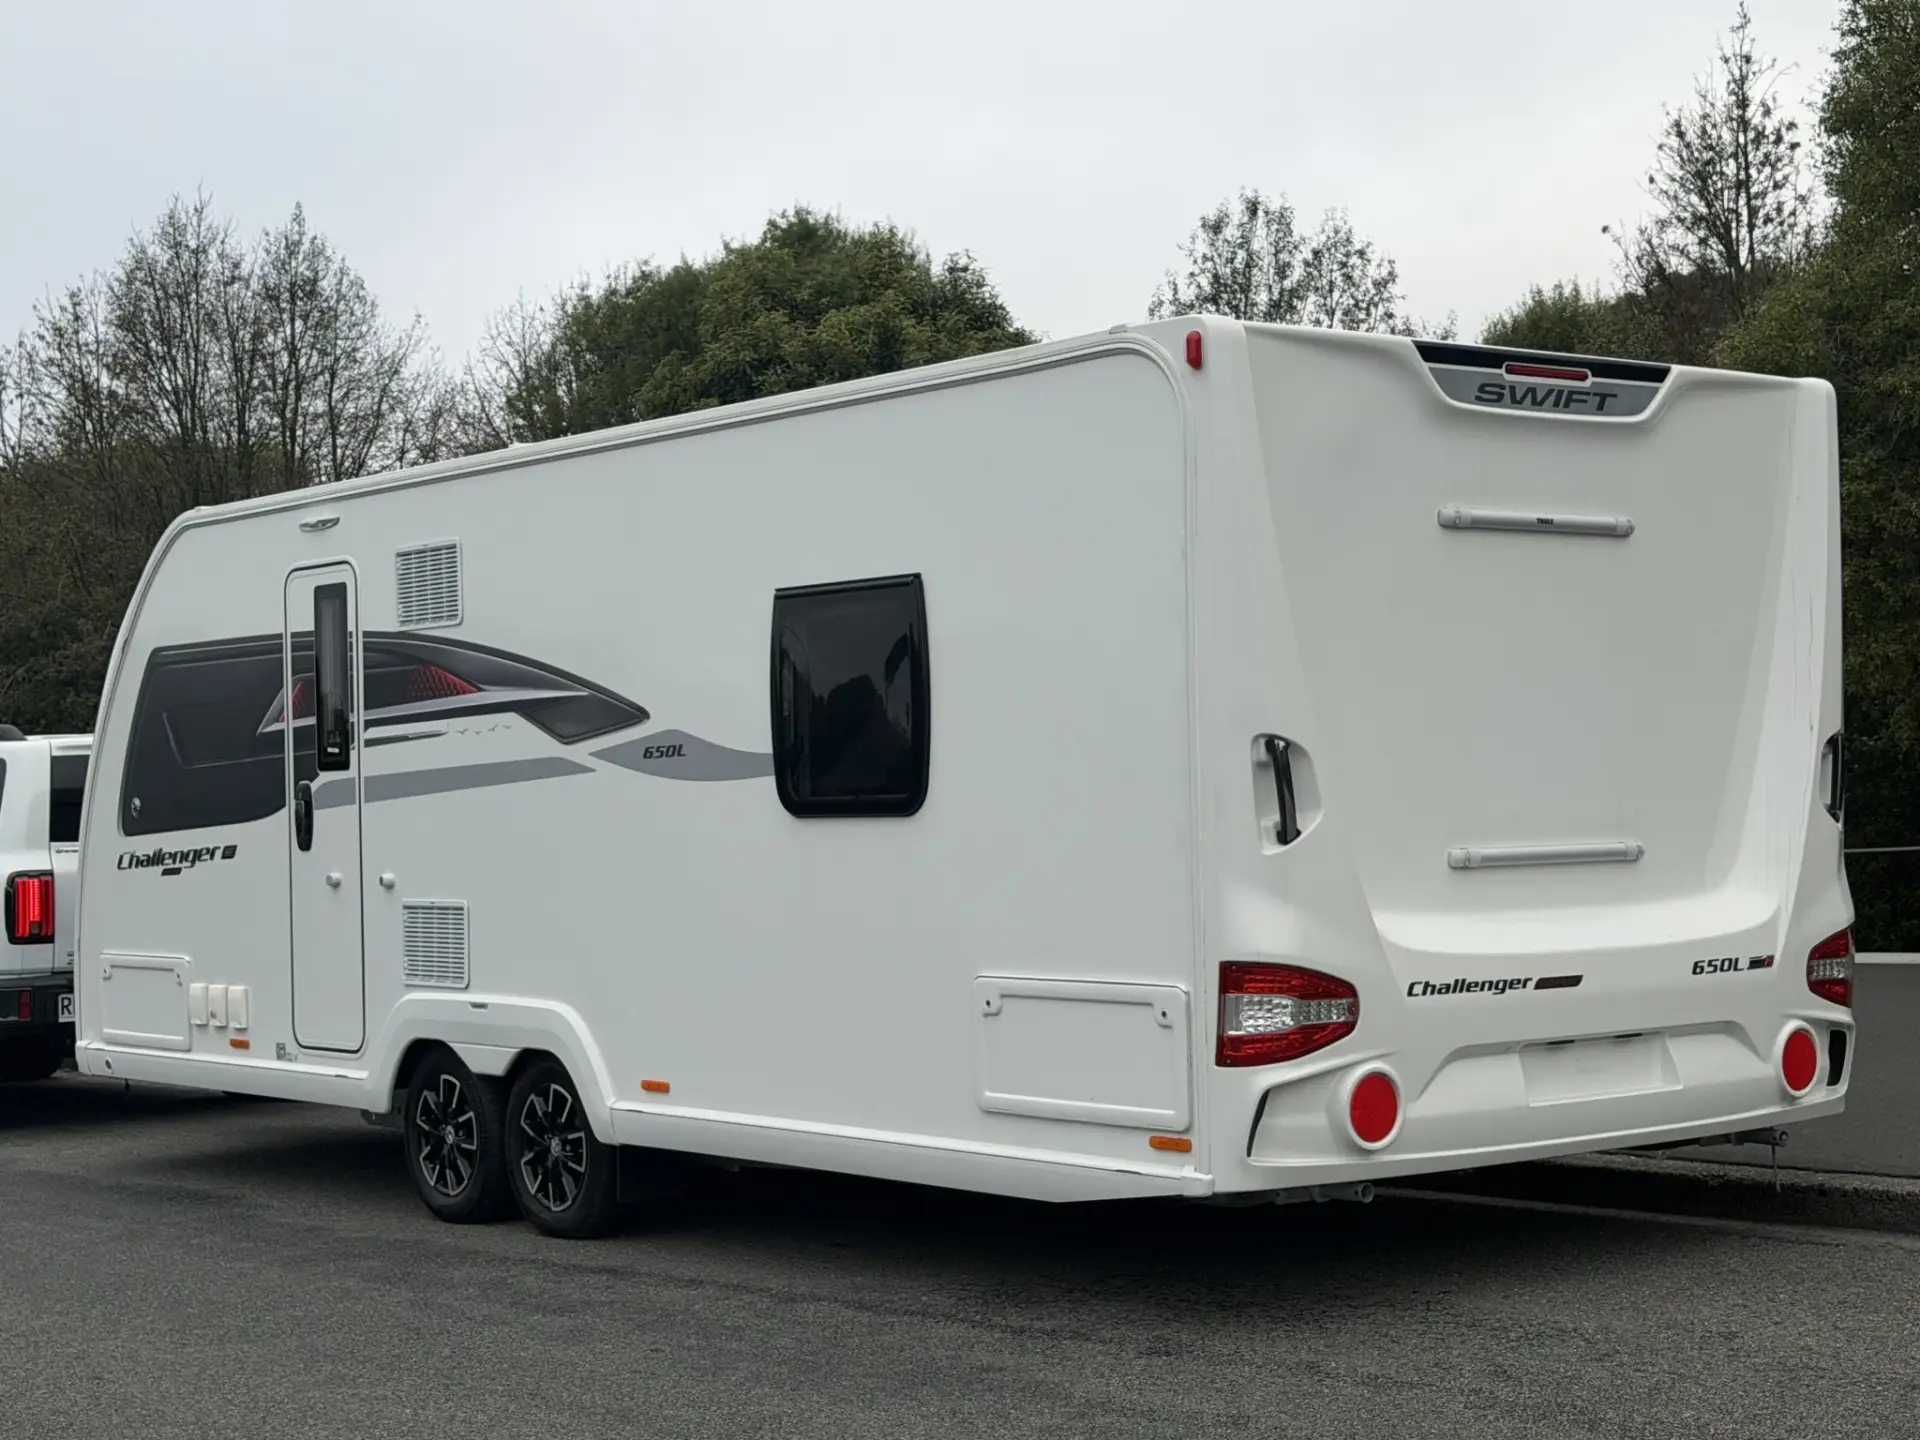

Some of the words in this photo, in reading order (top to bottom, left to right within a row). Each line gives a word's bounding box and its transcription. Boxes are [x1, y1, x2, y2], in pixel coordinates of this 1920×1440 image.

[1475, 383, 1618, 411] SWIFT
[643, 744, 687, 759] 650L
[117, 846, 221, 870] Challenger
[1692, 957, 1744, 975] 650L
[1406, 977, 1533, 997] Challenger
[61, 997, 75, 1015] R
